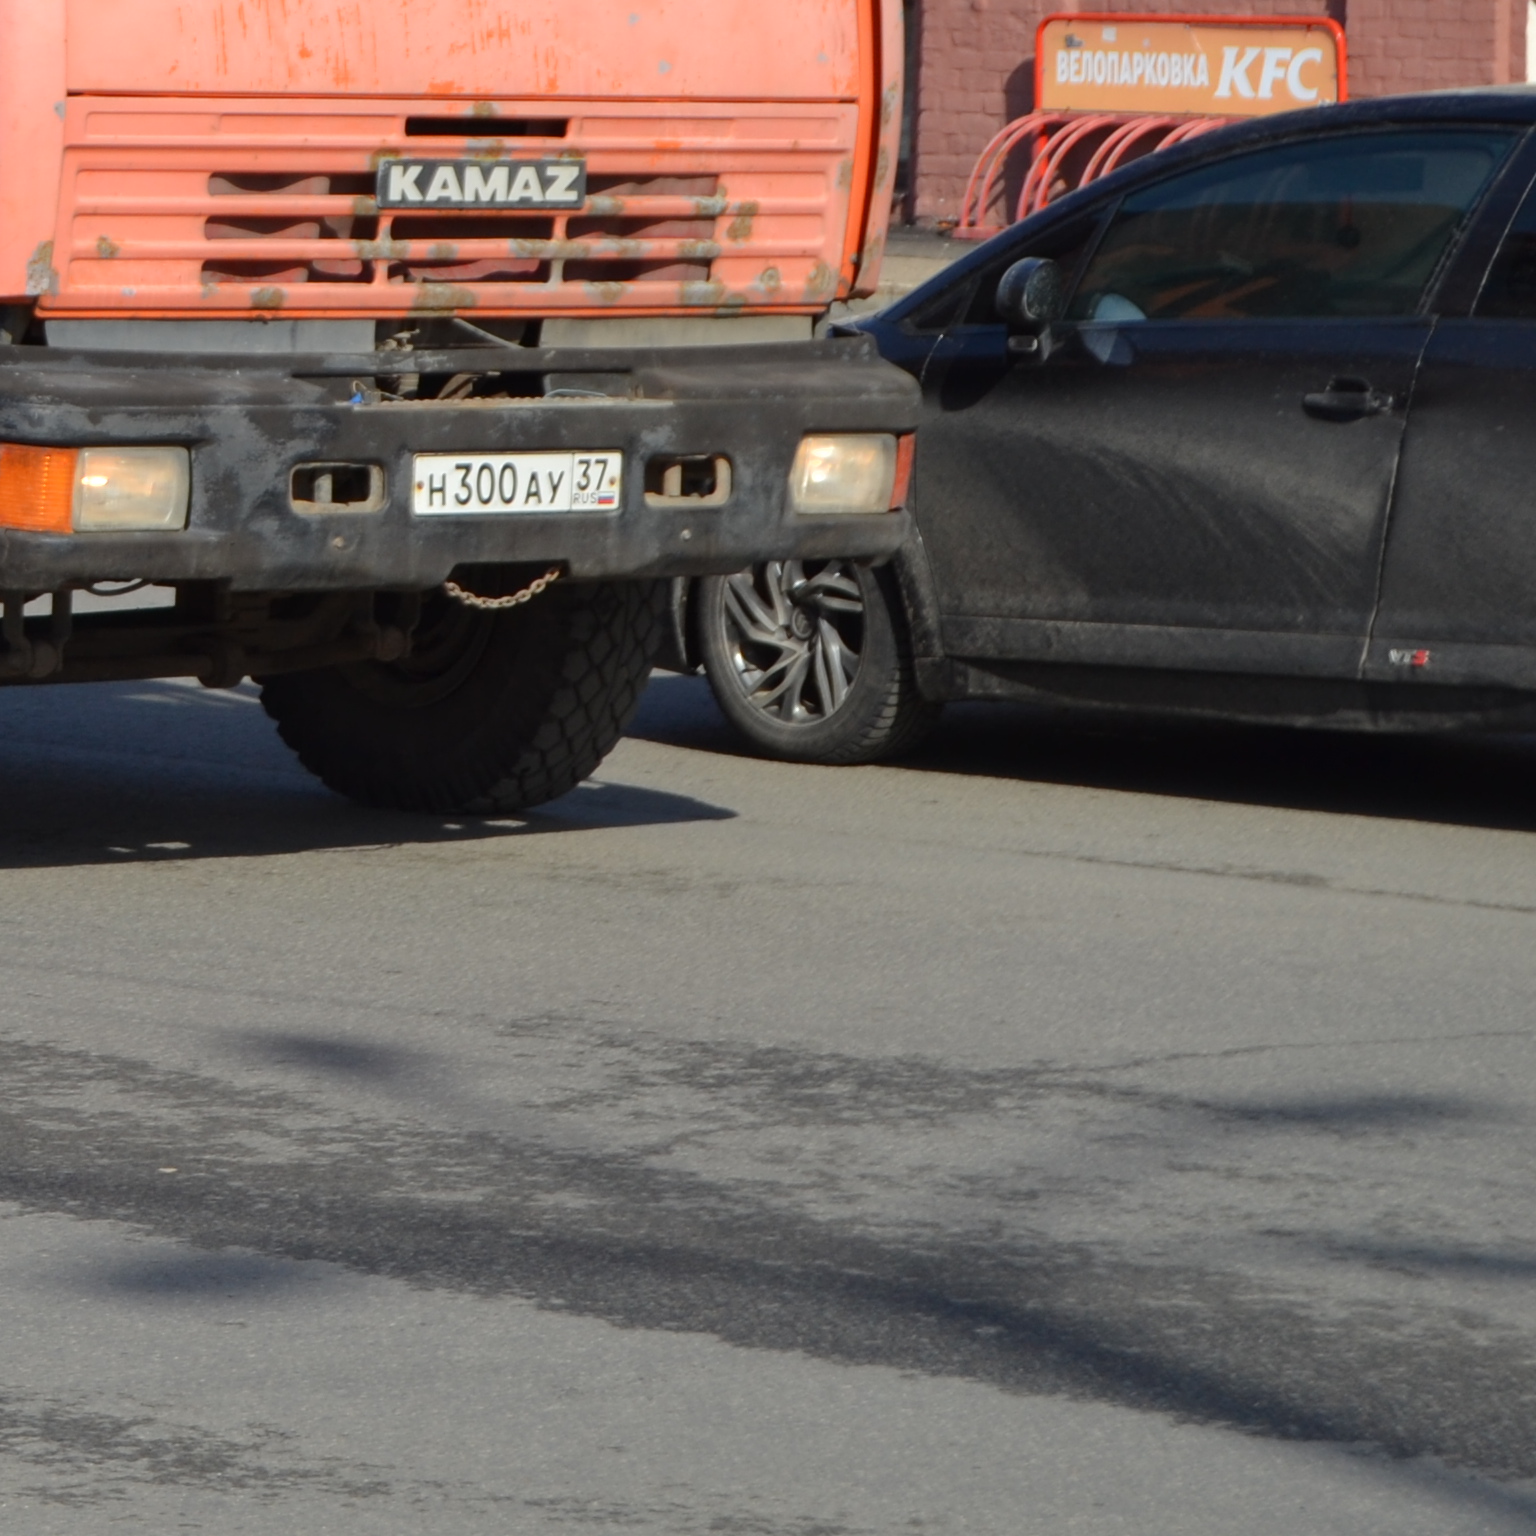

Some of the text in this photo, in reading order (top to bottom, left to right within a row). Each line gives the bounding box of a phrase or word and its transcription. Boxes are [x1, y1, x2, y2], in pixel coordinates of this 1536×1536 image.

[1056, 46, 1323, 101] ВЕЛОПАРКОВКА KFC
[388, 165, 580, 202] KAMAZ
[577, 458, 609, 491] 37
[573, 492, 597, 505] RUS
